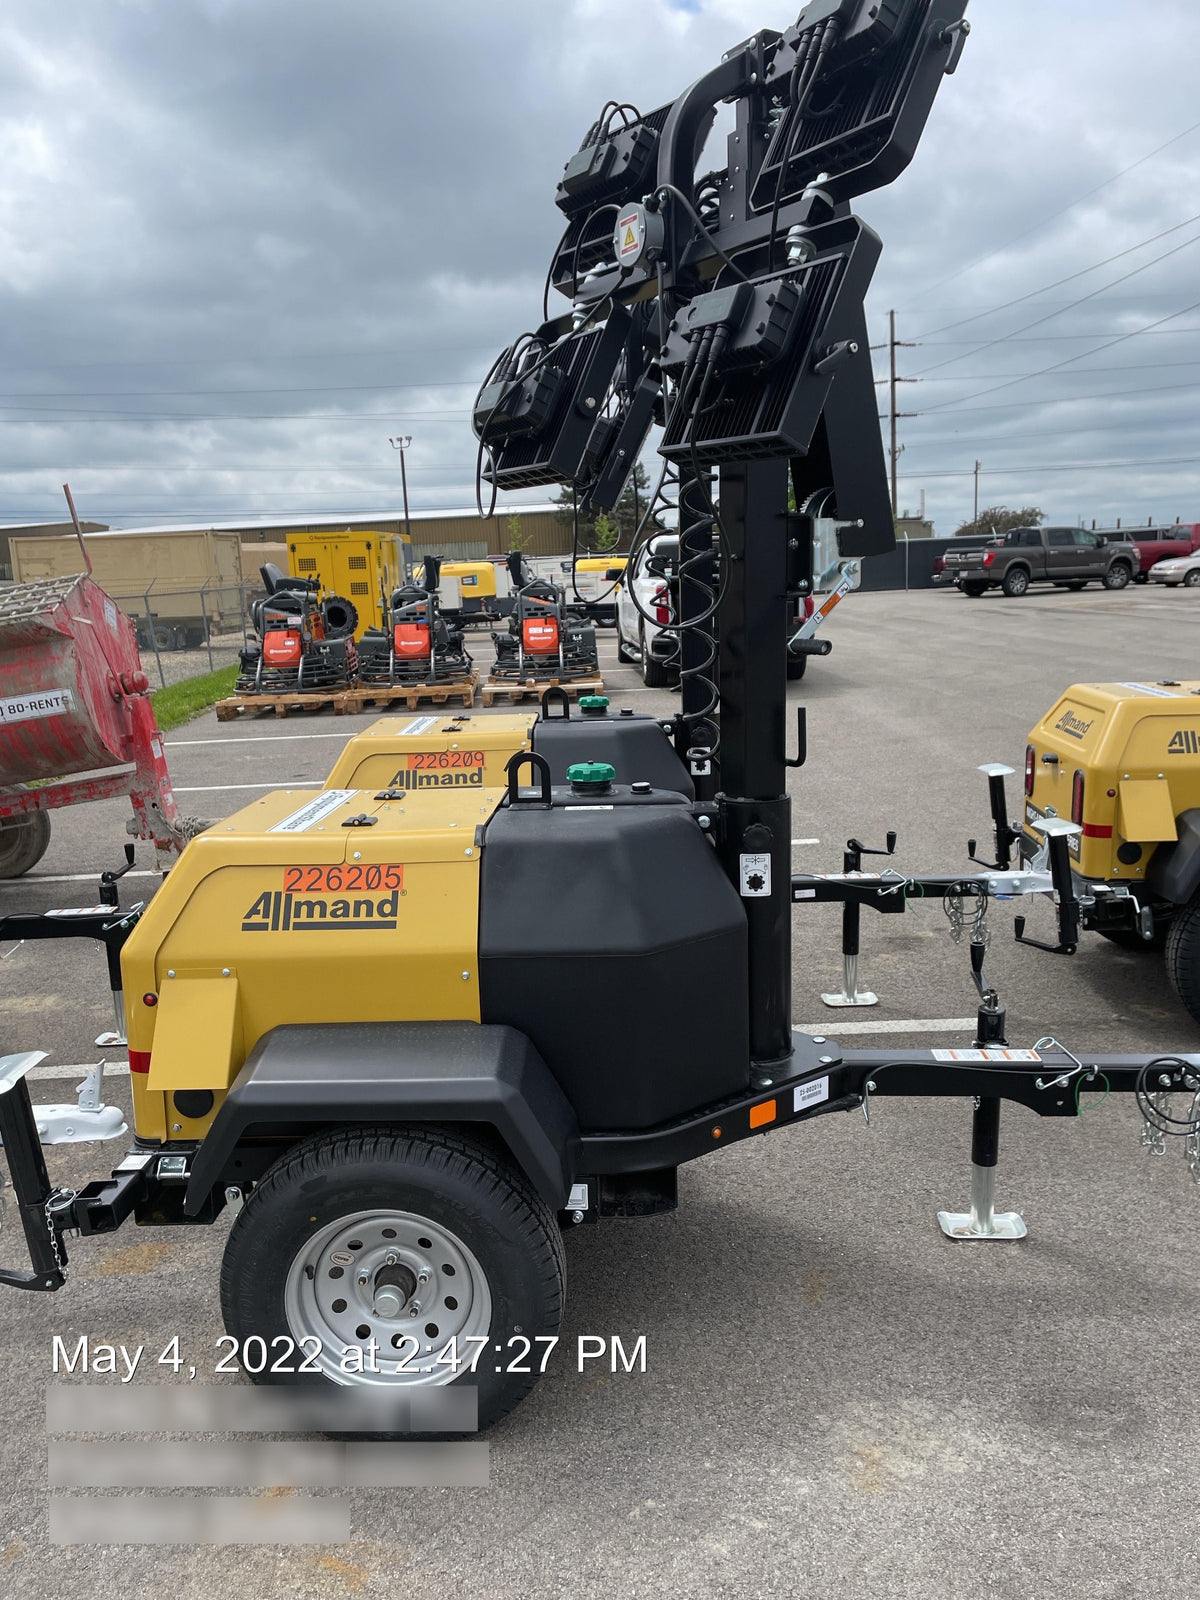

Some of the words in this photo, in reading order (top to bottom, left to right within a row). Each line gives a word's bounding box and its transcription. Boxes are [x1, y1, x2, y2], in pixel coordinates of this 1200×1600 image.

[8, 696, 70, 714] 80-RENTS
[1055, 710, 1092, 740] Allmand
[1168, 730, 1200, 754] All
[414, 751, 485, 769] 226209
[388, 767, 483, 790] Allmand
[285, 865, 401, 892] 226205
[241, 890, 399, 931] Allmand
